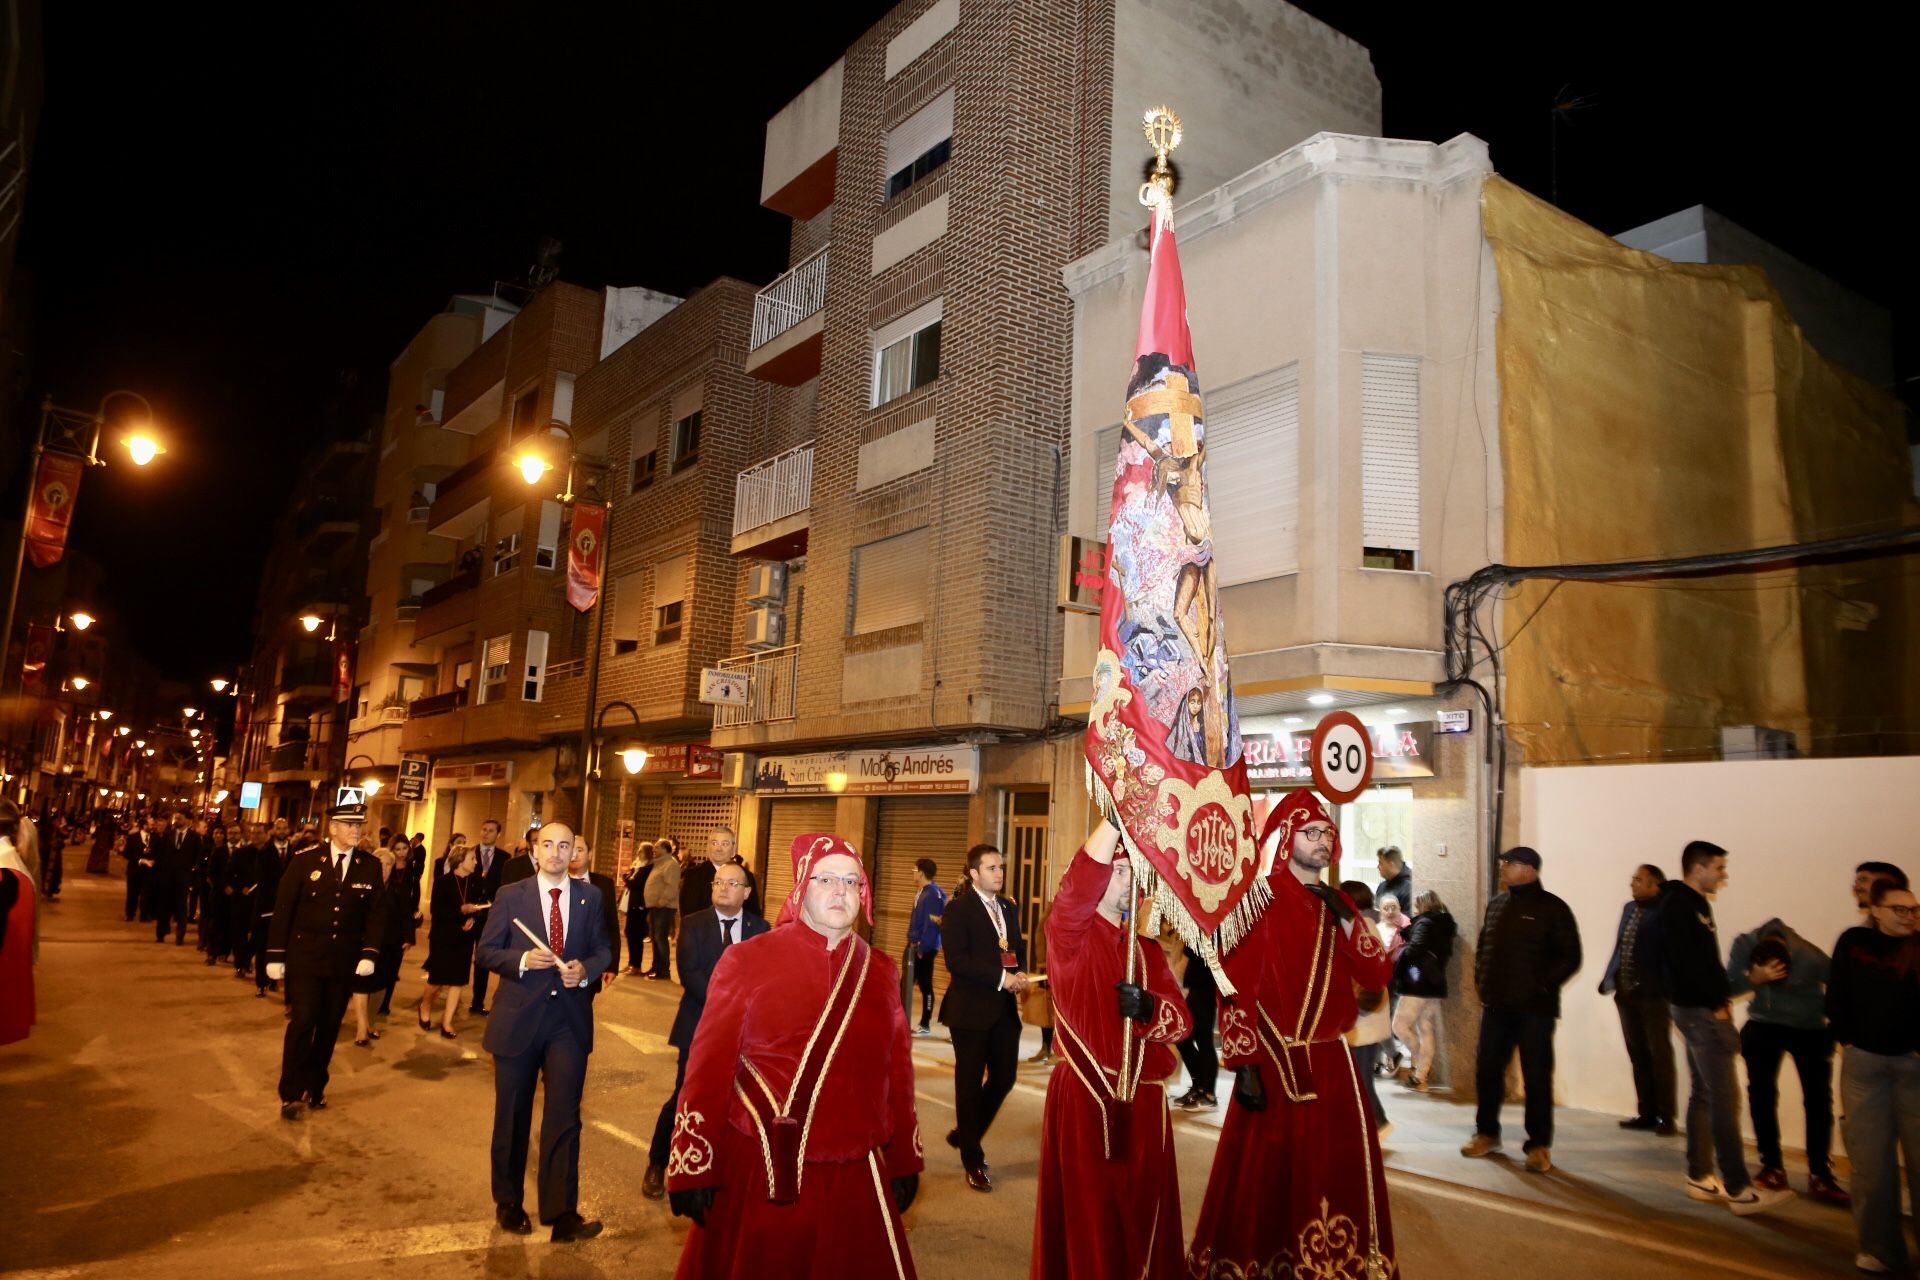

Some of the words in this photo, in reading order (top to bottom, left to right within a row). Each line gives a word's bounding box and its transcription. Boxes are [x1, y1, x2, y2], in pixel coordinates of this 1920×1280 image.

[902, 754, 954, 775] Andrés
[1327, 741, 1362, 774] 30
[408, 762, 420, 775] P
